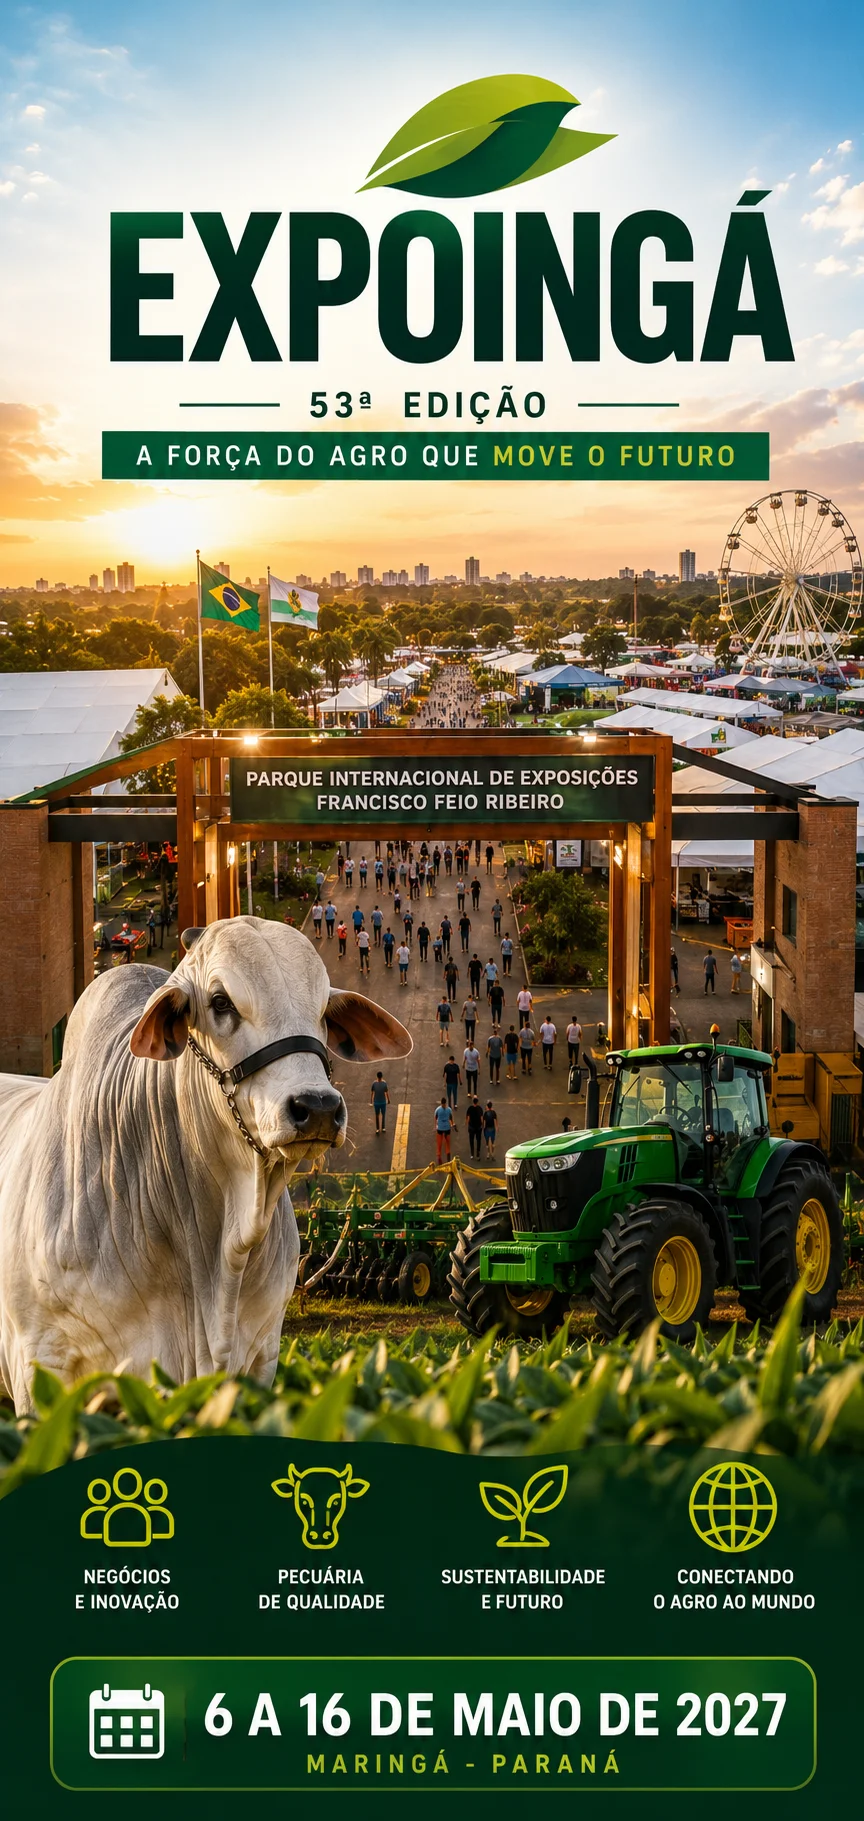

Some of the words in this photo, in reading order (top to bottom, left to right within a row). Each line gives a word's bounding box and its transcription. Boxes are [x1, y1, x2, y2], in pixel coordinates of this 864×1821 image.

[246, 771, 323, 788] PARQUE
[330, 770, 484, 787] INTERNACIONAL
[489, 770, 514, 786] DE
[520, 766, 638, 789] EXPOSIÇÕES
[317, 794, 427, 811] FRANCISCO
[434, 794, 478, 810] FEIO
[486, 793, 564, 810] RIBEIRO
